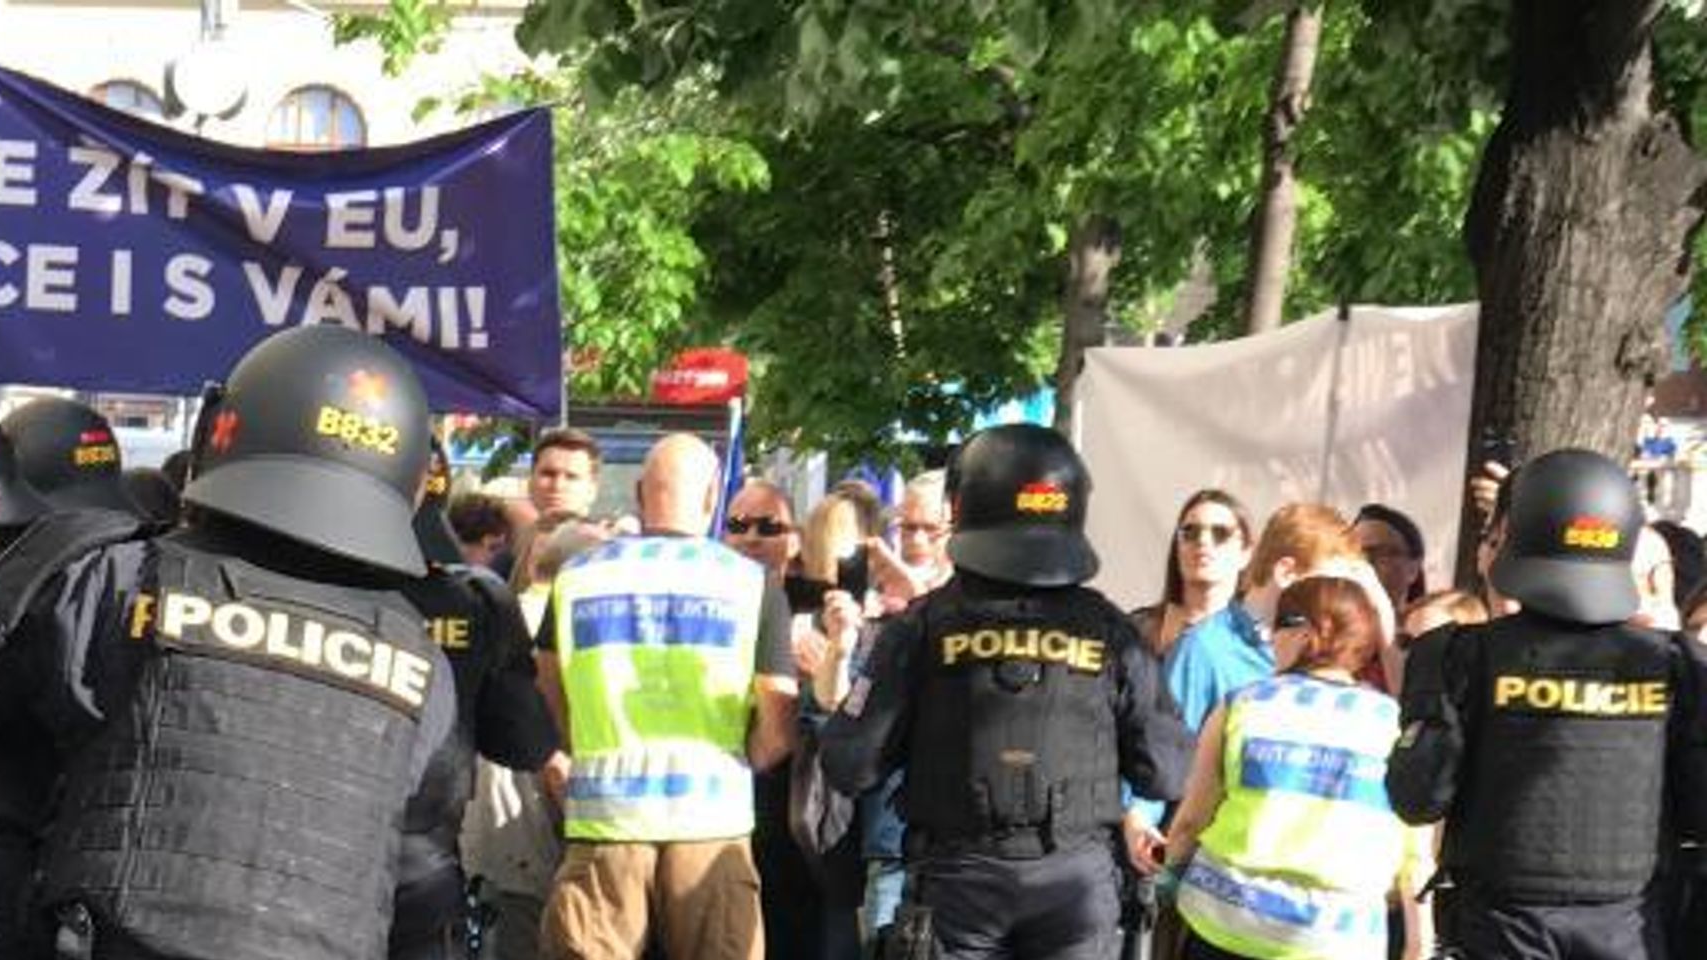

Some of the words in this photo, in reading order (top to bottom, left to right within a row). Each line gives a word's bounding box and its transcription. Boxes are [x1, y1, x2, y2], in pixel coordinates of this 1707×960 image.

[232, 183, 293, 244] V
[325, 186, 459, 262] EU,
[110, 249, 132, 314] I
[163, 253, 215, 320] S
[243, 261, 489, 349] VÁMI!
[316, 405, 399, 455] B832
[162, 592, 433, 707] POLICIE
[942, 629, 1106, 671] POLICIE
[1495, 676, 1668, 714] POLICIE
